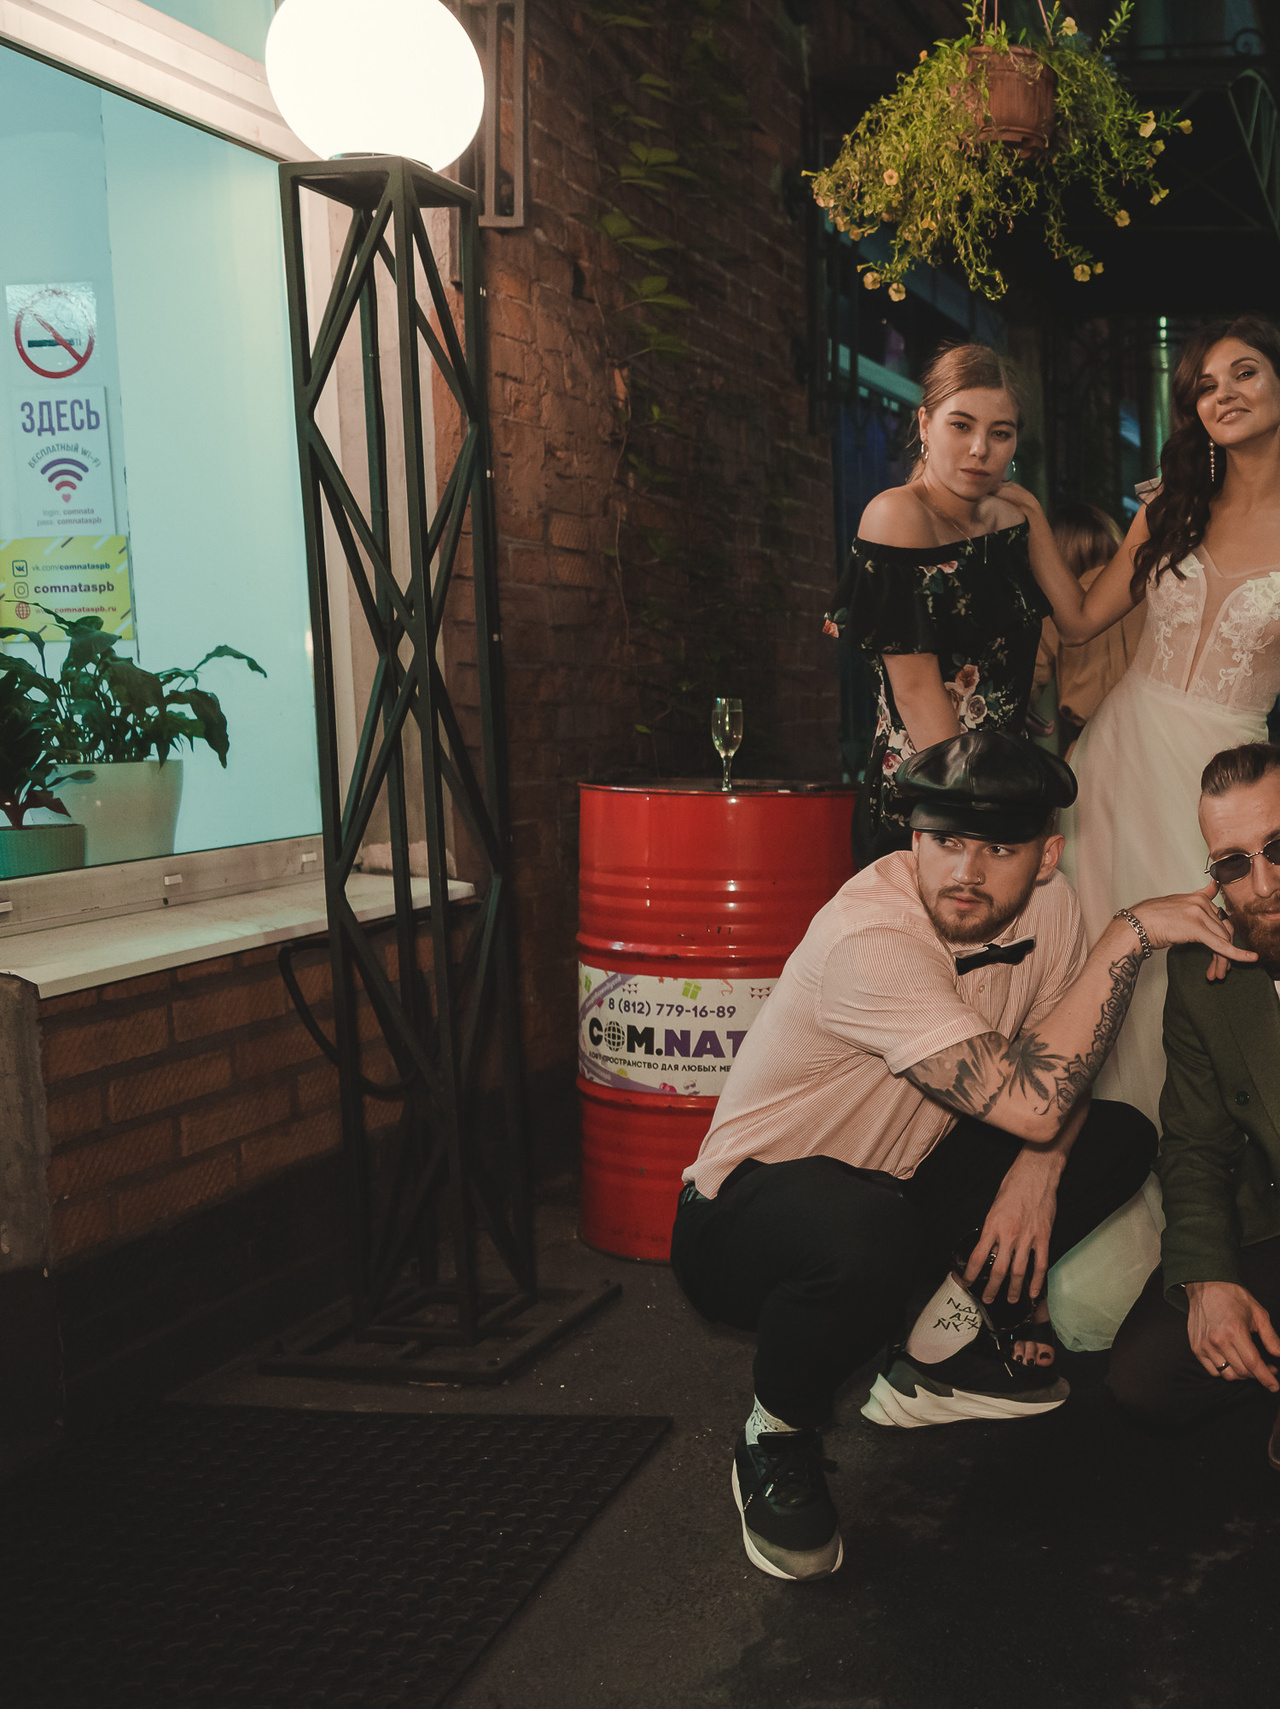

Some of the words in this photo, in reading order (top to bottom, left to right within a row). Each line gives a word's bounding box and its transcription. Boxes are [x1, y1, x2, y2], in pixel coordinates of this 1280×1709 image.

[20, 399, 100, 436] ЗДЕСЬ
[28, 443, 79, 469] БЕСПЛАТНЫЙ
[57, 517, 102, 525] comnataspb
[34, 581, 115, 594] comnataspb
[608, 998, 615, 1010] 8
[618, 998, 651, 1017] (812)
[656, 1003, 737, 1018] 779-16-89
[661, 1063, 679, 1071] ДЛЯ
[681, 1064, 717, 1073] ЛЮБЫХ
